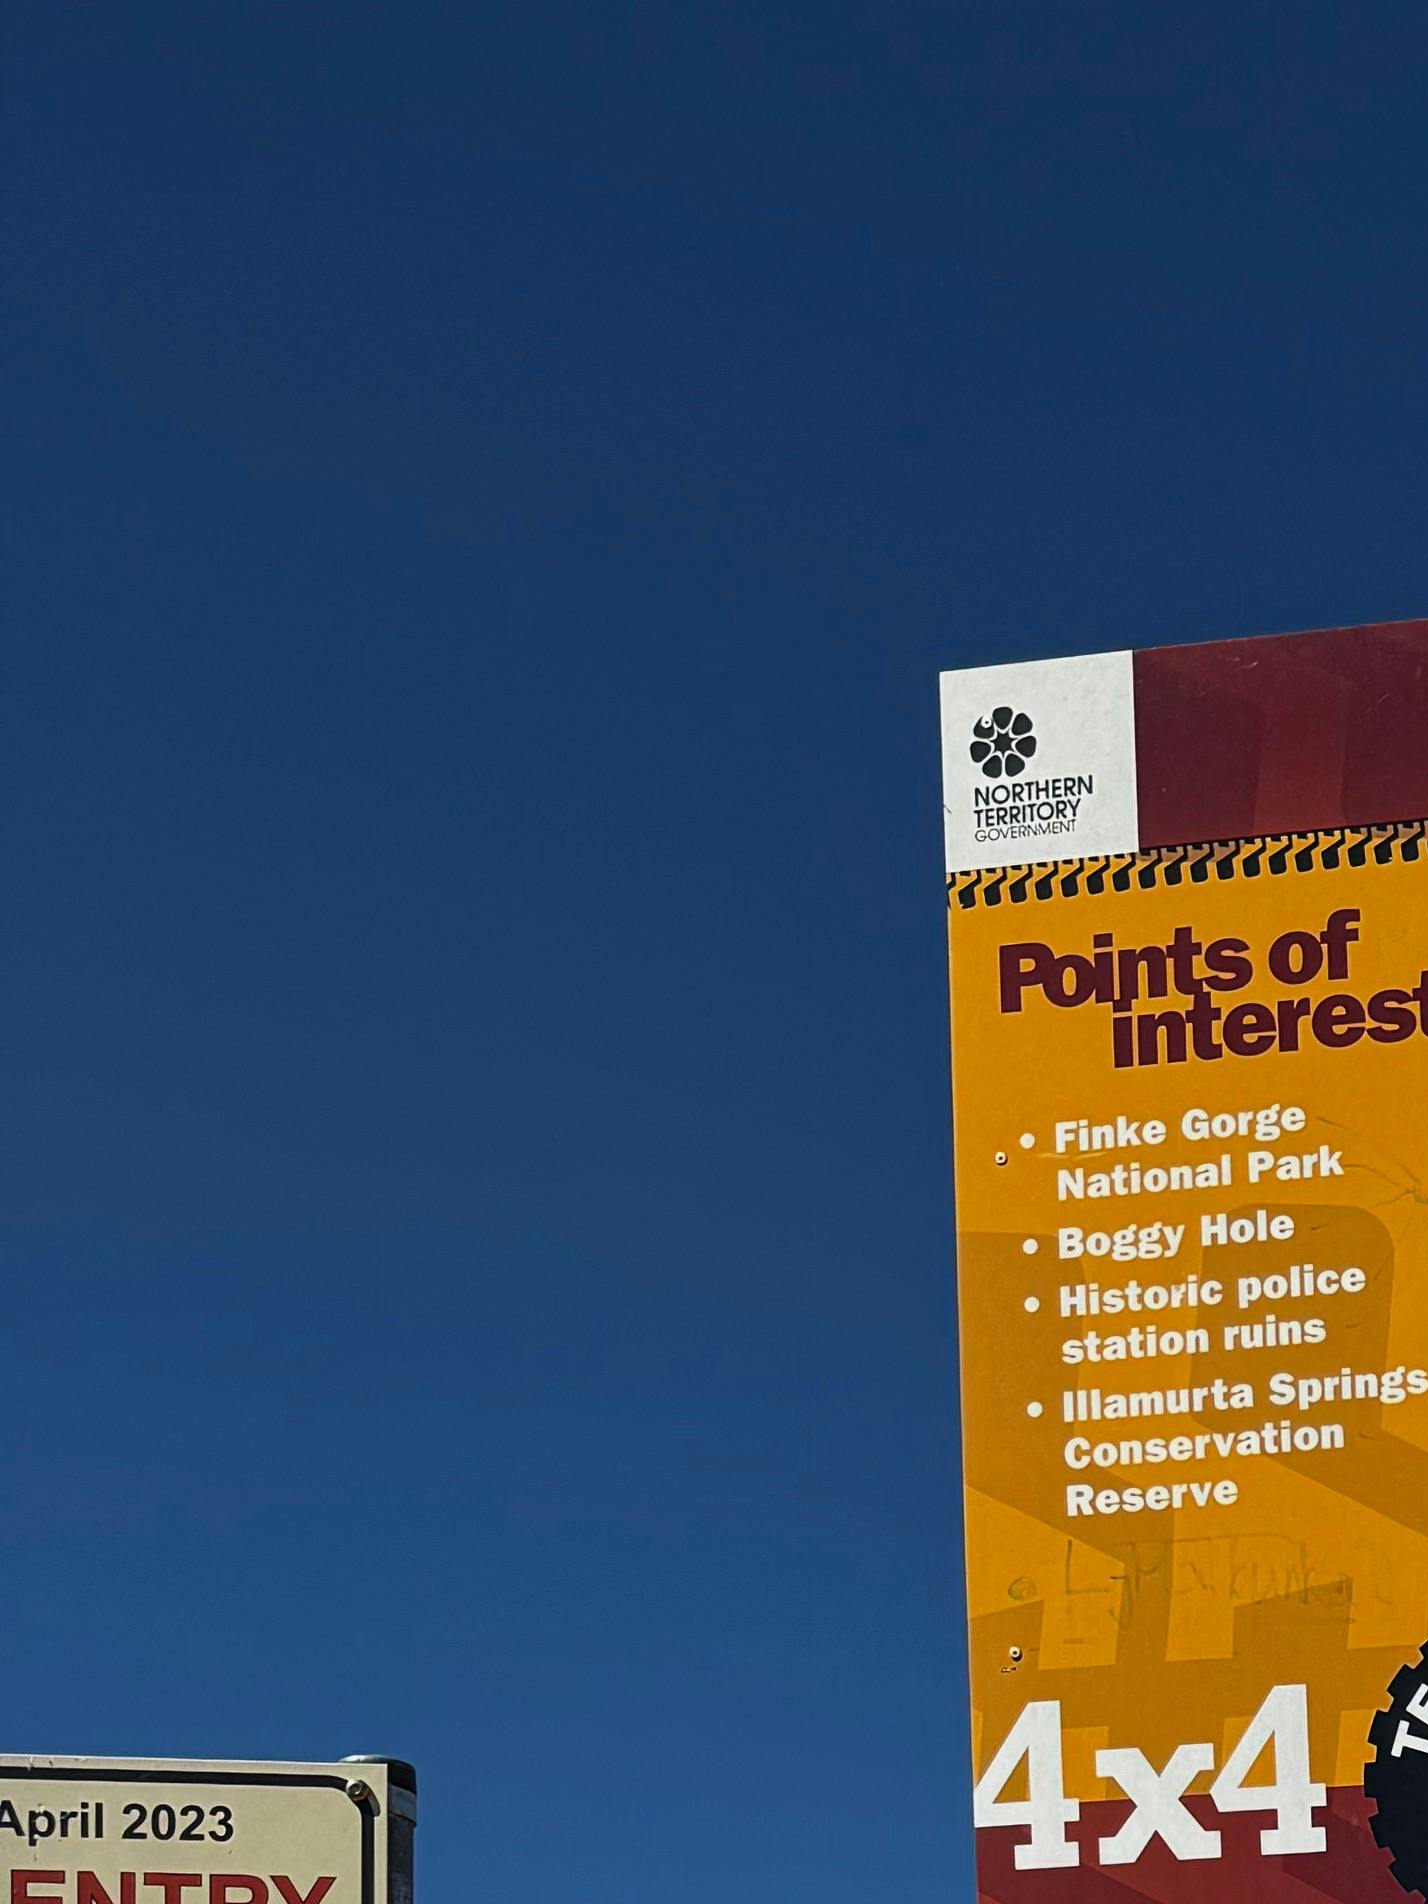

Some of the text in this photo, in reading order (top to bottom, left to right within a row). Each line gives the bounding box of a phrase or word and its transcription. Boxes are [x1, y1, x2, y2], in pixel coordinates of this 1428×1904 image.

[974, 798, 1081, 828] TERRITORY
[975, 775, 1092, 806] NORTHERN
[975, 819, 1076, 842] GOVERNMENT
[998, 909, 1360, 1013] Points of
[1055, 1104, 1305, 1153] Finke Gorge
[1057, 1145, 1343, 1200] National Park
[1058, 1210, 1294, 1261] Boggy Hole
[1063, 1367, 1428, 1422] Illamurta Springs
[1064, 1420, 1344, 1469] Conservation
[1067, 1480, 1237, 1516] Reserve
[973, 1684, 1326, 1869] 4x4
[0, 1800, 233, 1846] April 2023
